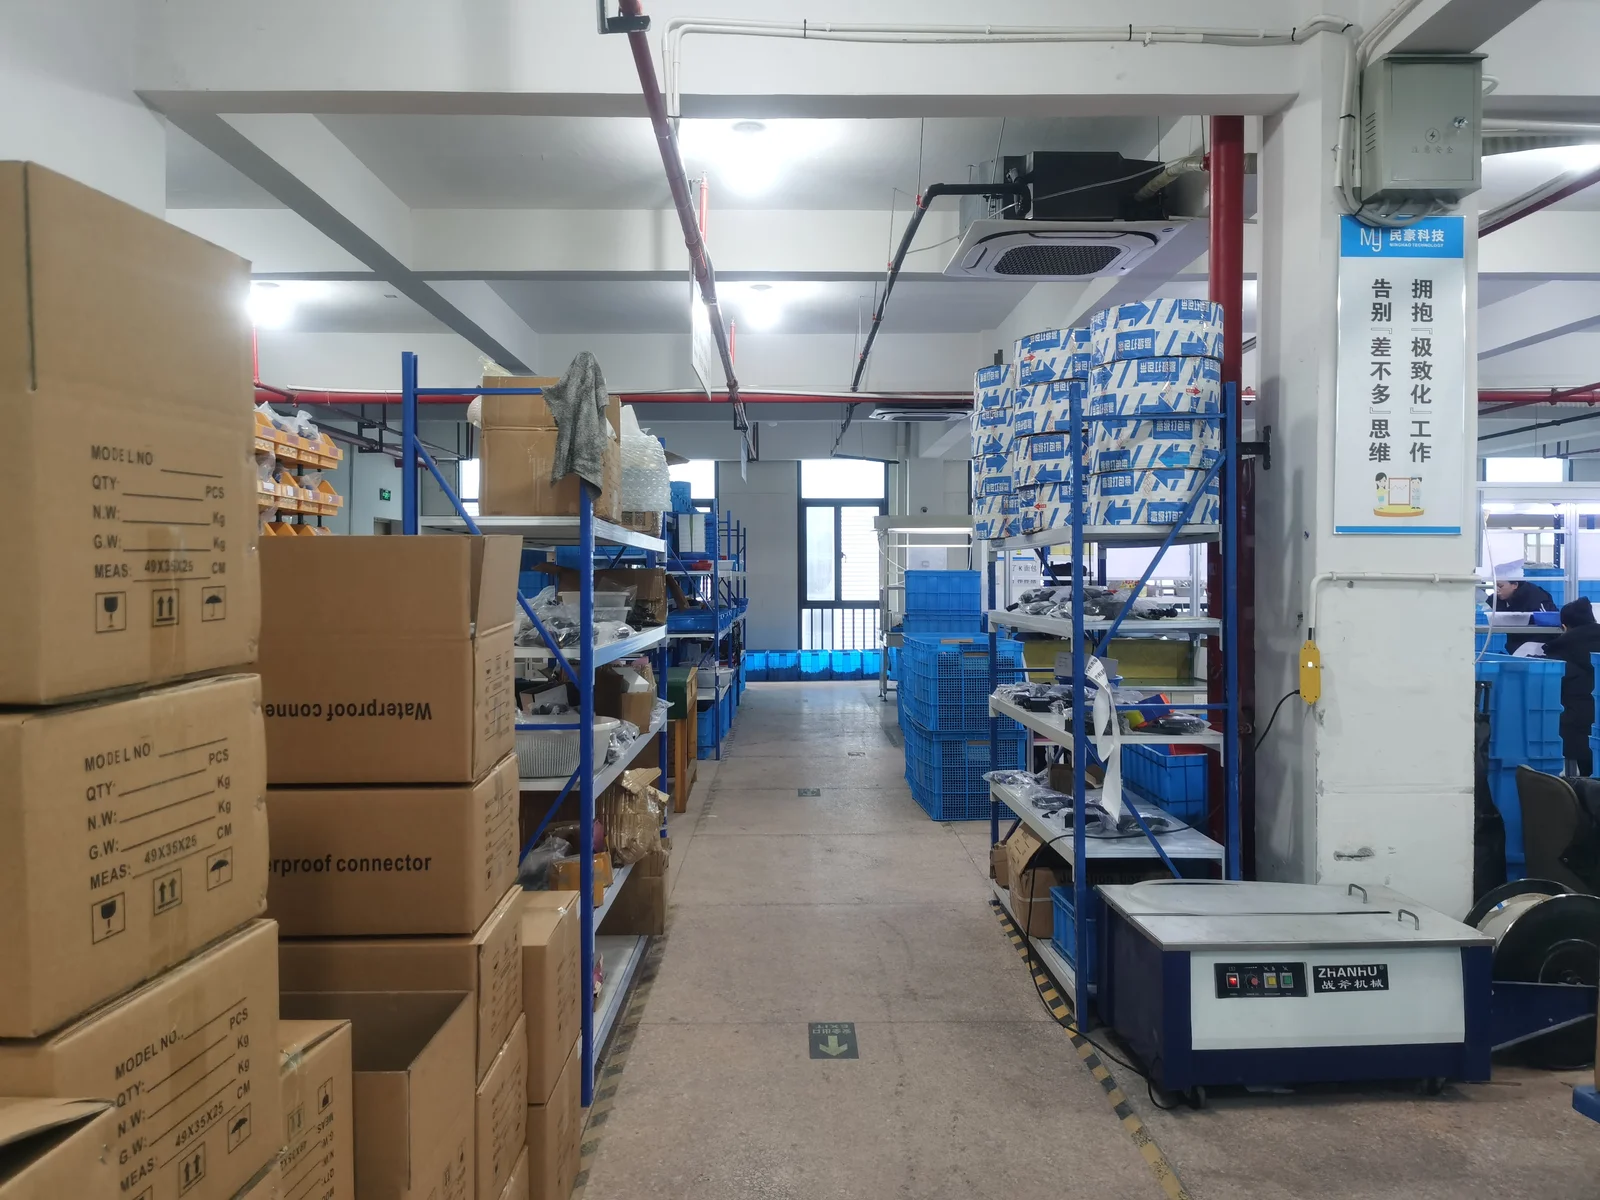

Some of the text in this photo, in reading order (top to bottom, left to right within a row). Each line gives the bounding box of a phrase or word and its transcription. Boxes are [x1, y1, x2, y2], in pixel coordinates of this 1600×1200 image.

[1389, 229, 1445, 242] 民豪科技
[1118, 337, 1152, 352] 高级打包带
[1140, 361, 1177, 373] 高级打包带
[1156, 420, 1191, 432] 高级打包带
[1102, 476, 1131, 488] 高级打包带
[205, 486, 225, 499] PCS
[213, 512, 225, 527] Kg
[213, 537, 225, 552] Kg
[94, 563, 132, 579] MEAS:
[212, 562, 226, 574] CM
[261, 700, 432, 721] Waterproof conne
[85, 747, 130, 772] MODEL
[208, 749, 229, 765] PCS
[87, 774, 230, 831] N.W: Kg
[89, 800, 231, 860] G.W: Kg
[90, 822, 232, 890] MEAS: 49X35X25 CM
[337, 855, 432, 873] connector
[1321, 978, 1384, 990] 战斧机械
[229, 1008, 248, 1030] PCS
[115, 1043, 159, 1080] MODEL
[118, 1034, 249, 1139] N.W: Kg
[119, 1059, 250, 1165] G.W: Kg
[175, 1101, 224, 1147] 49X35X25
[237, 1080, 251, 1100] CM
